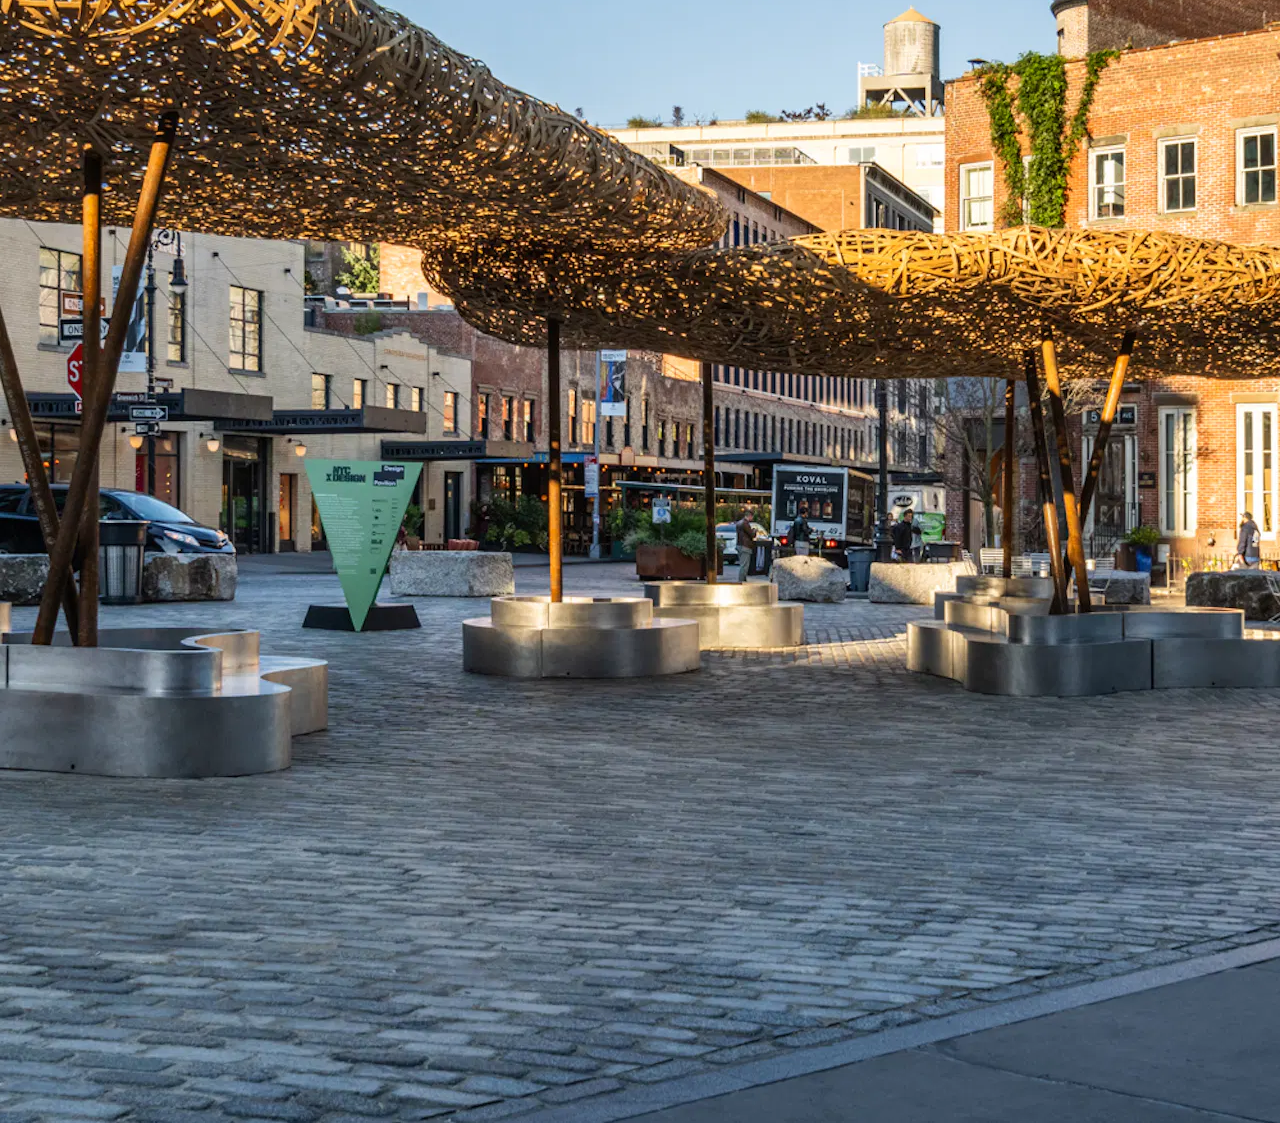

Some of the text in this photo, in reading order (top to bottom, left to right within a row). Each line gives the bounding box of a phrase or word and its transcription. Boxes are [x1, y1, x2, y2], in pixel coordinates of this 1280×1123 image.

[332, 466, 352, 475] NYC
[332, 474, 366, 483] DESIGN
[796, 475, 828, 485] KOVAL
